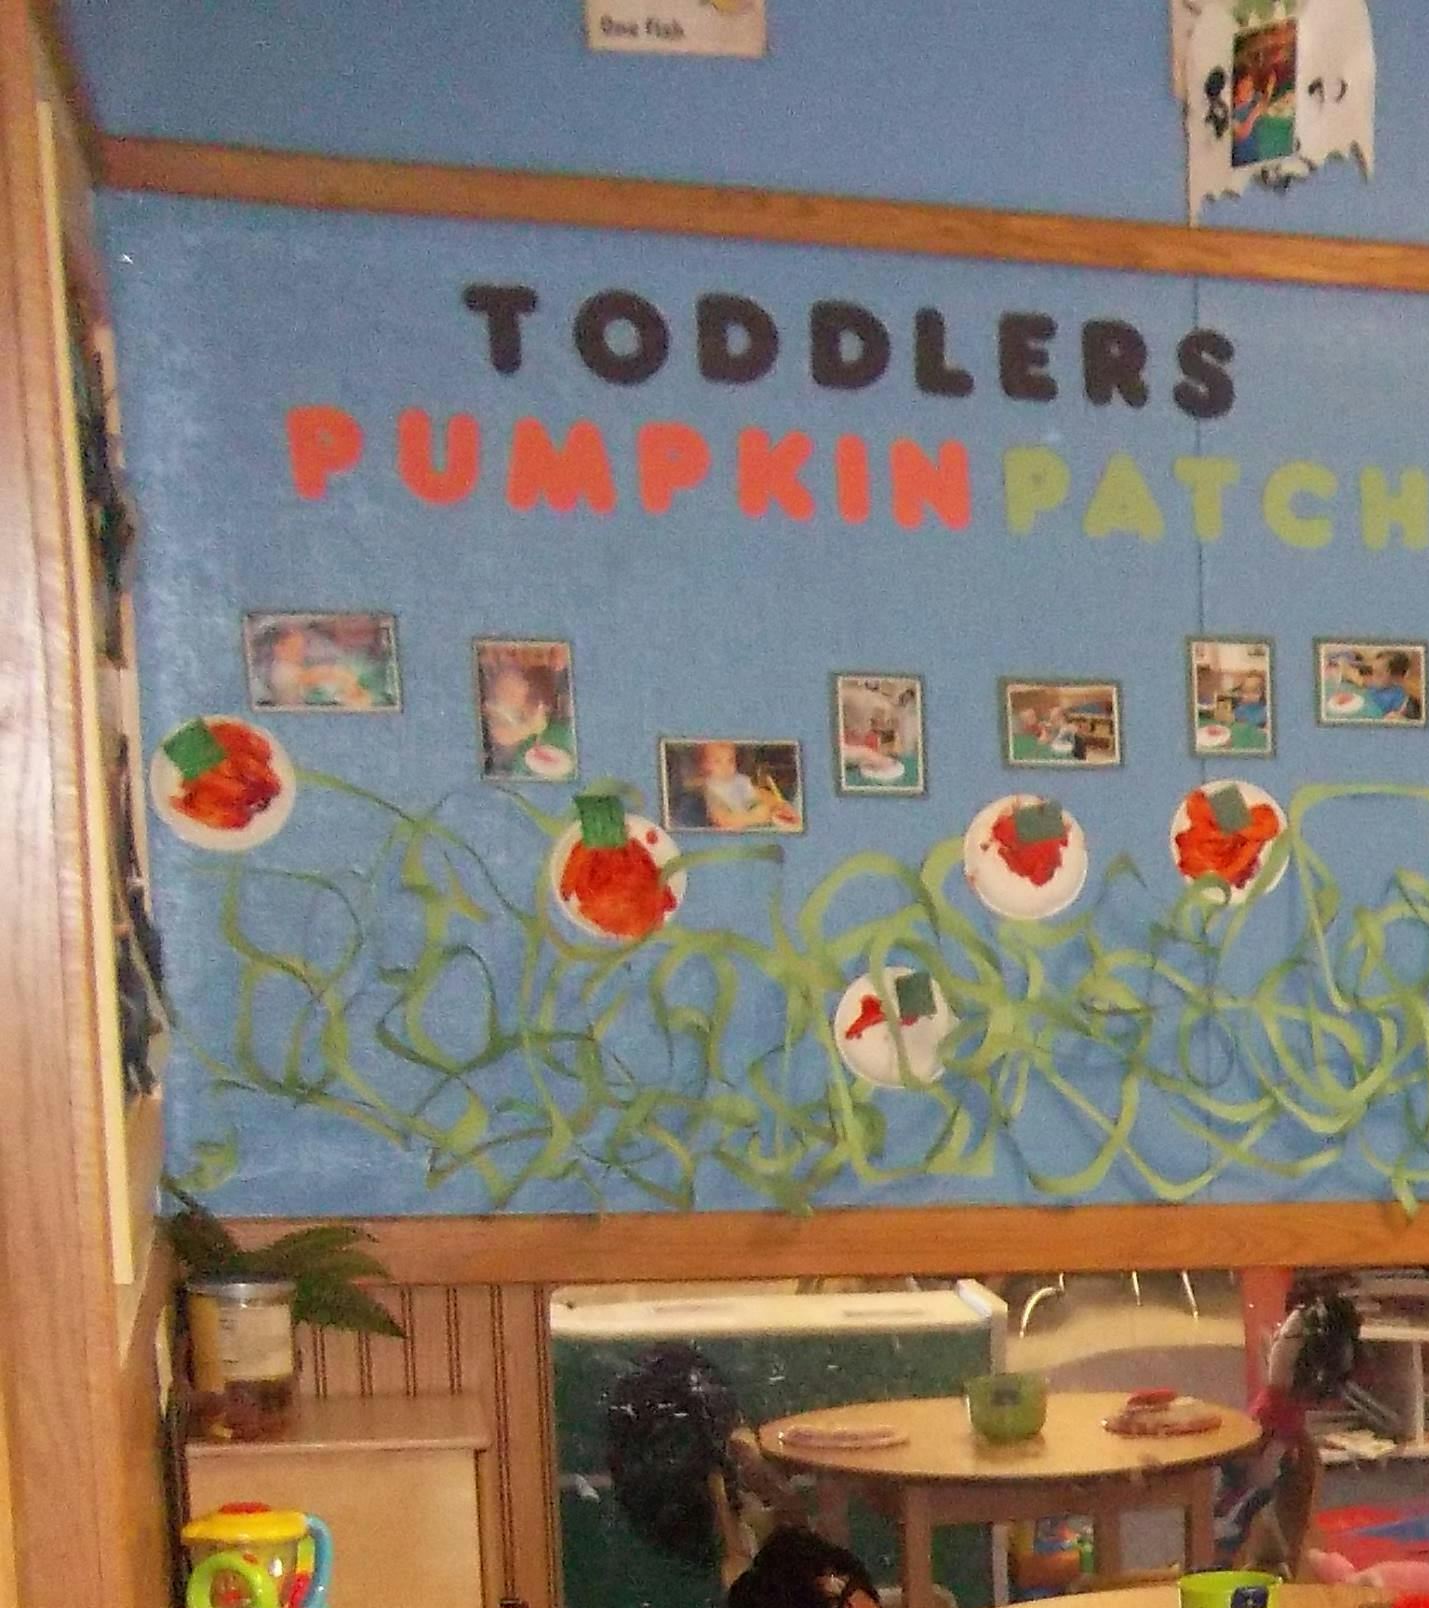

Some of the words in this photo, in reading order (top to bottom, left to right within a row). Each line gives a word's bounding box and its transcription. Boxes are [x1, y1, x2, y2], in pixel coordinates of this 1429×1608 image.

[465, 285, 1234, 418] TODDLERS
[288, 407, 969, 526] PUMPKIN
[1003, 447, 1429, 550] PATCH
